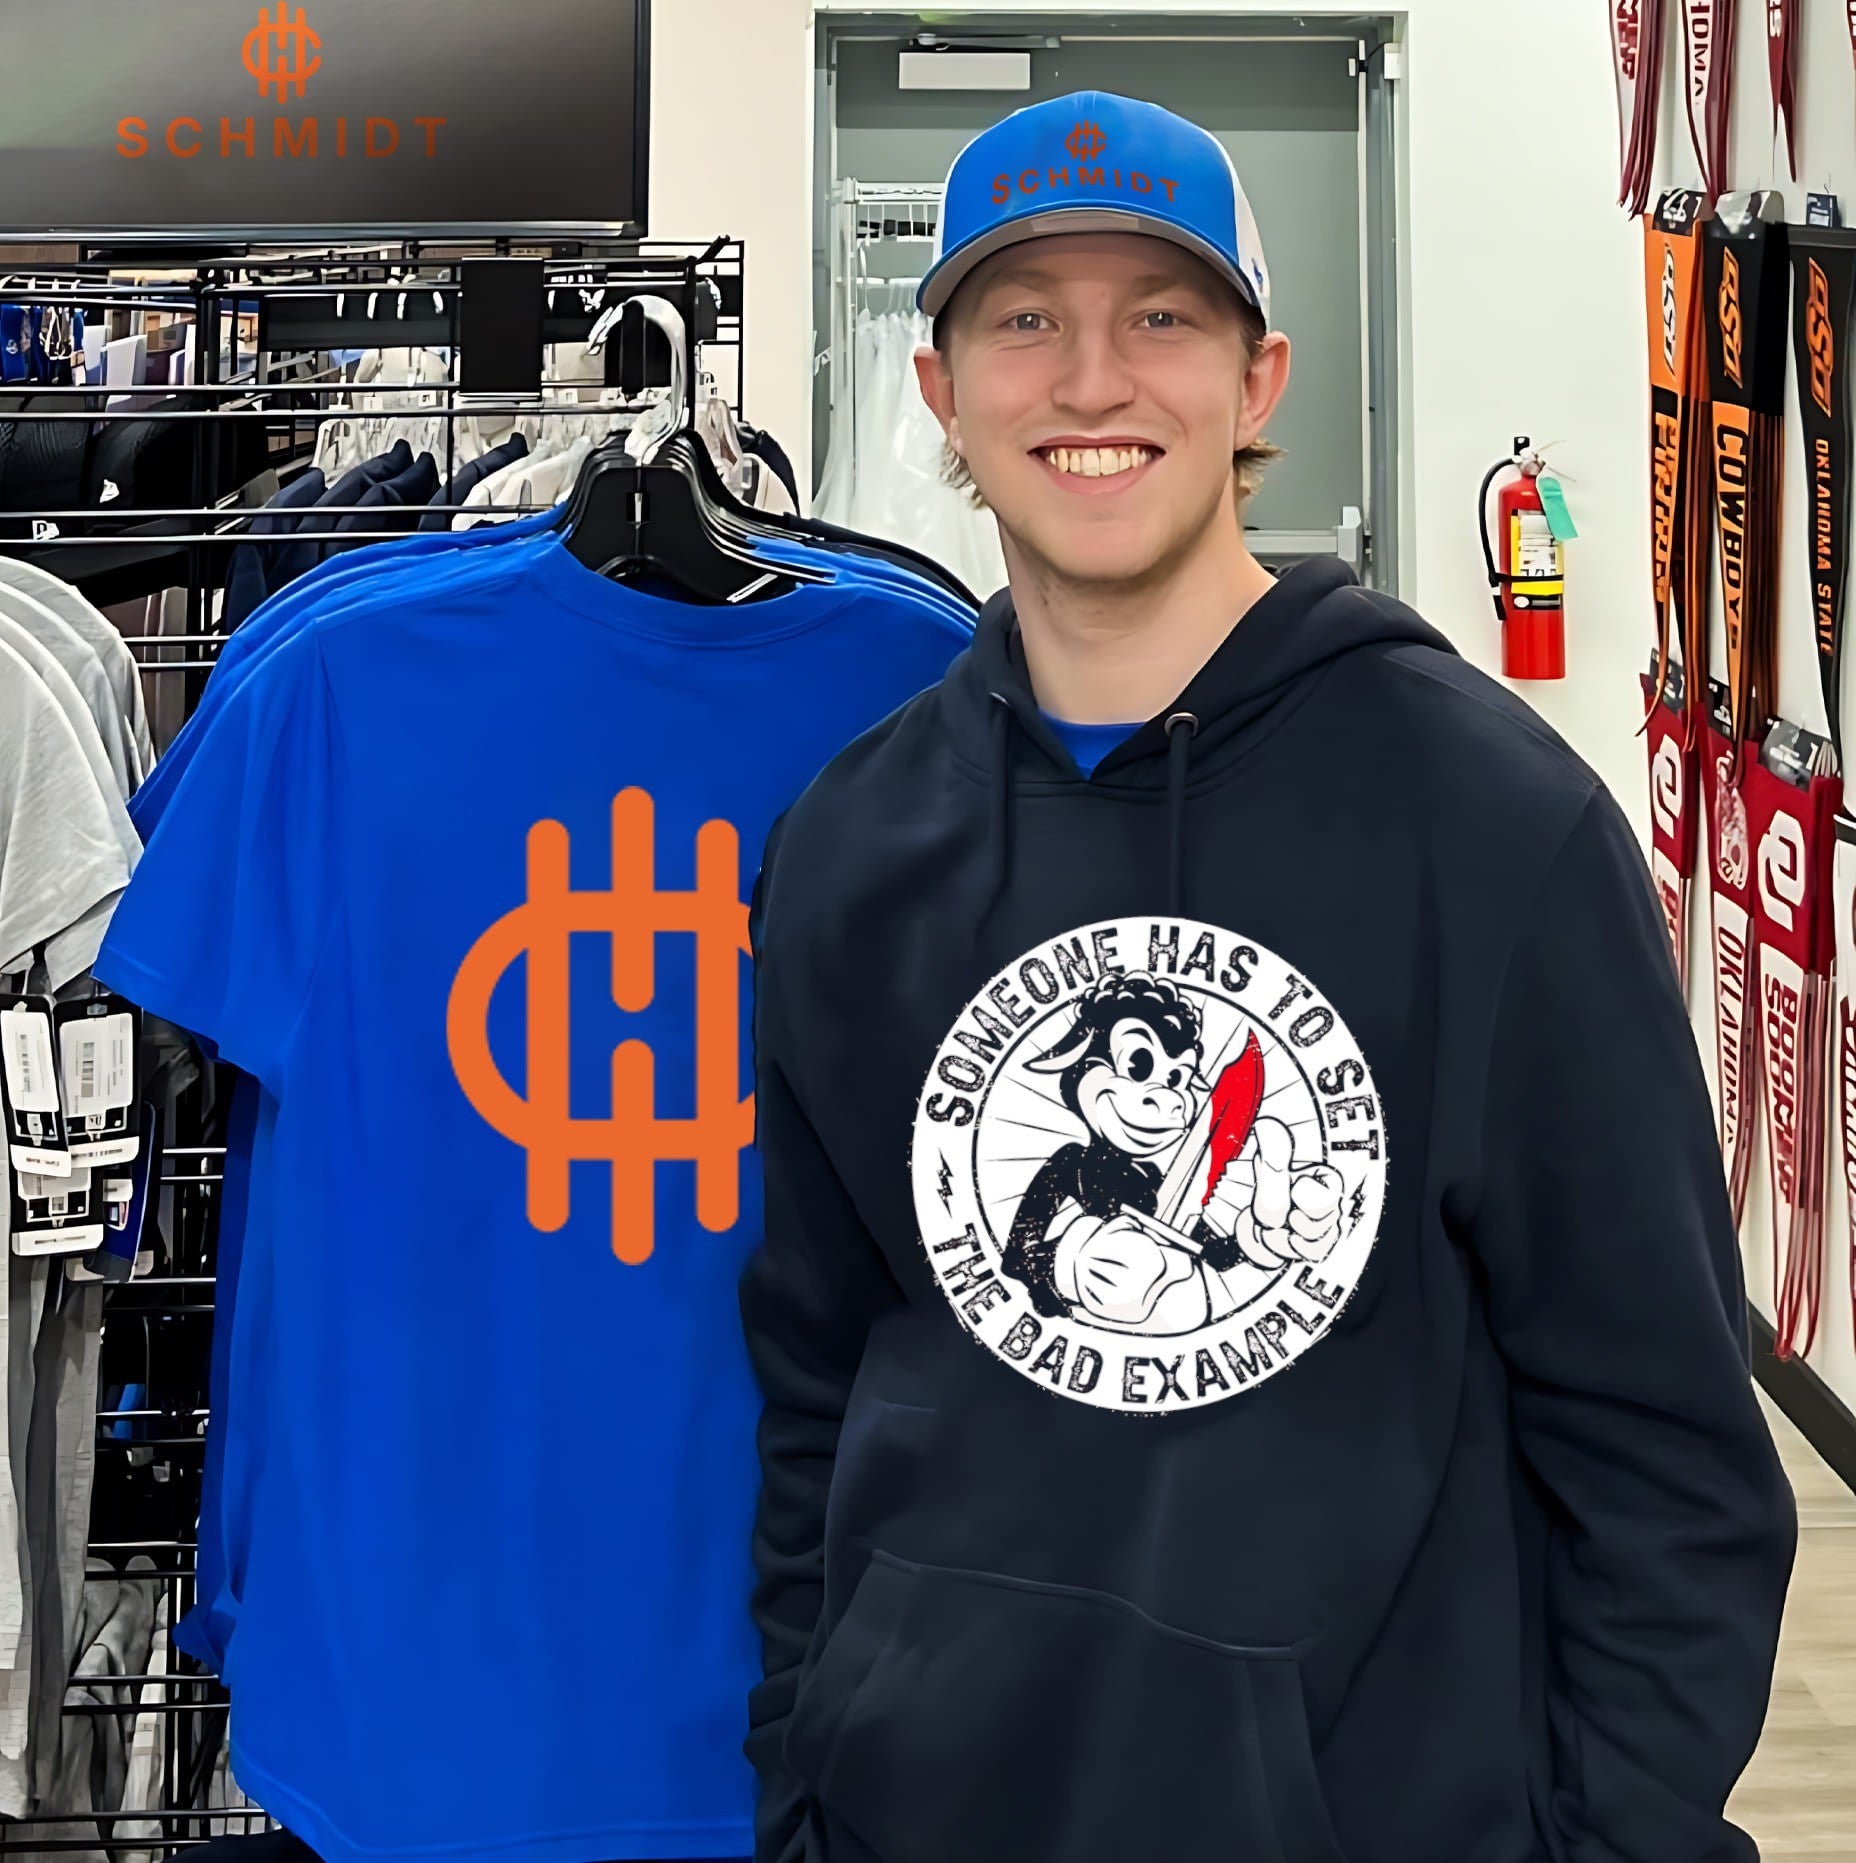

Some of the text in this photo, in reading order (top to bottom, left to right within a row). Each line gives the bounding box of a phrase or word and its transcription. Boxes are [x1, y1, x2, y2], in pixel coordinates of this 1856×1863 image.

[115, 116, 448, 160] SCHMIDT
[991, 166, 1179, 204] SCHMIDT
[926, 924, 1381, 1161] SOMEONE HAS TO SET
[932, 1223, 1345, 1404] THE BAD EXAMPLE
